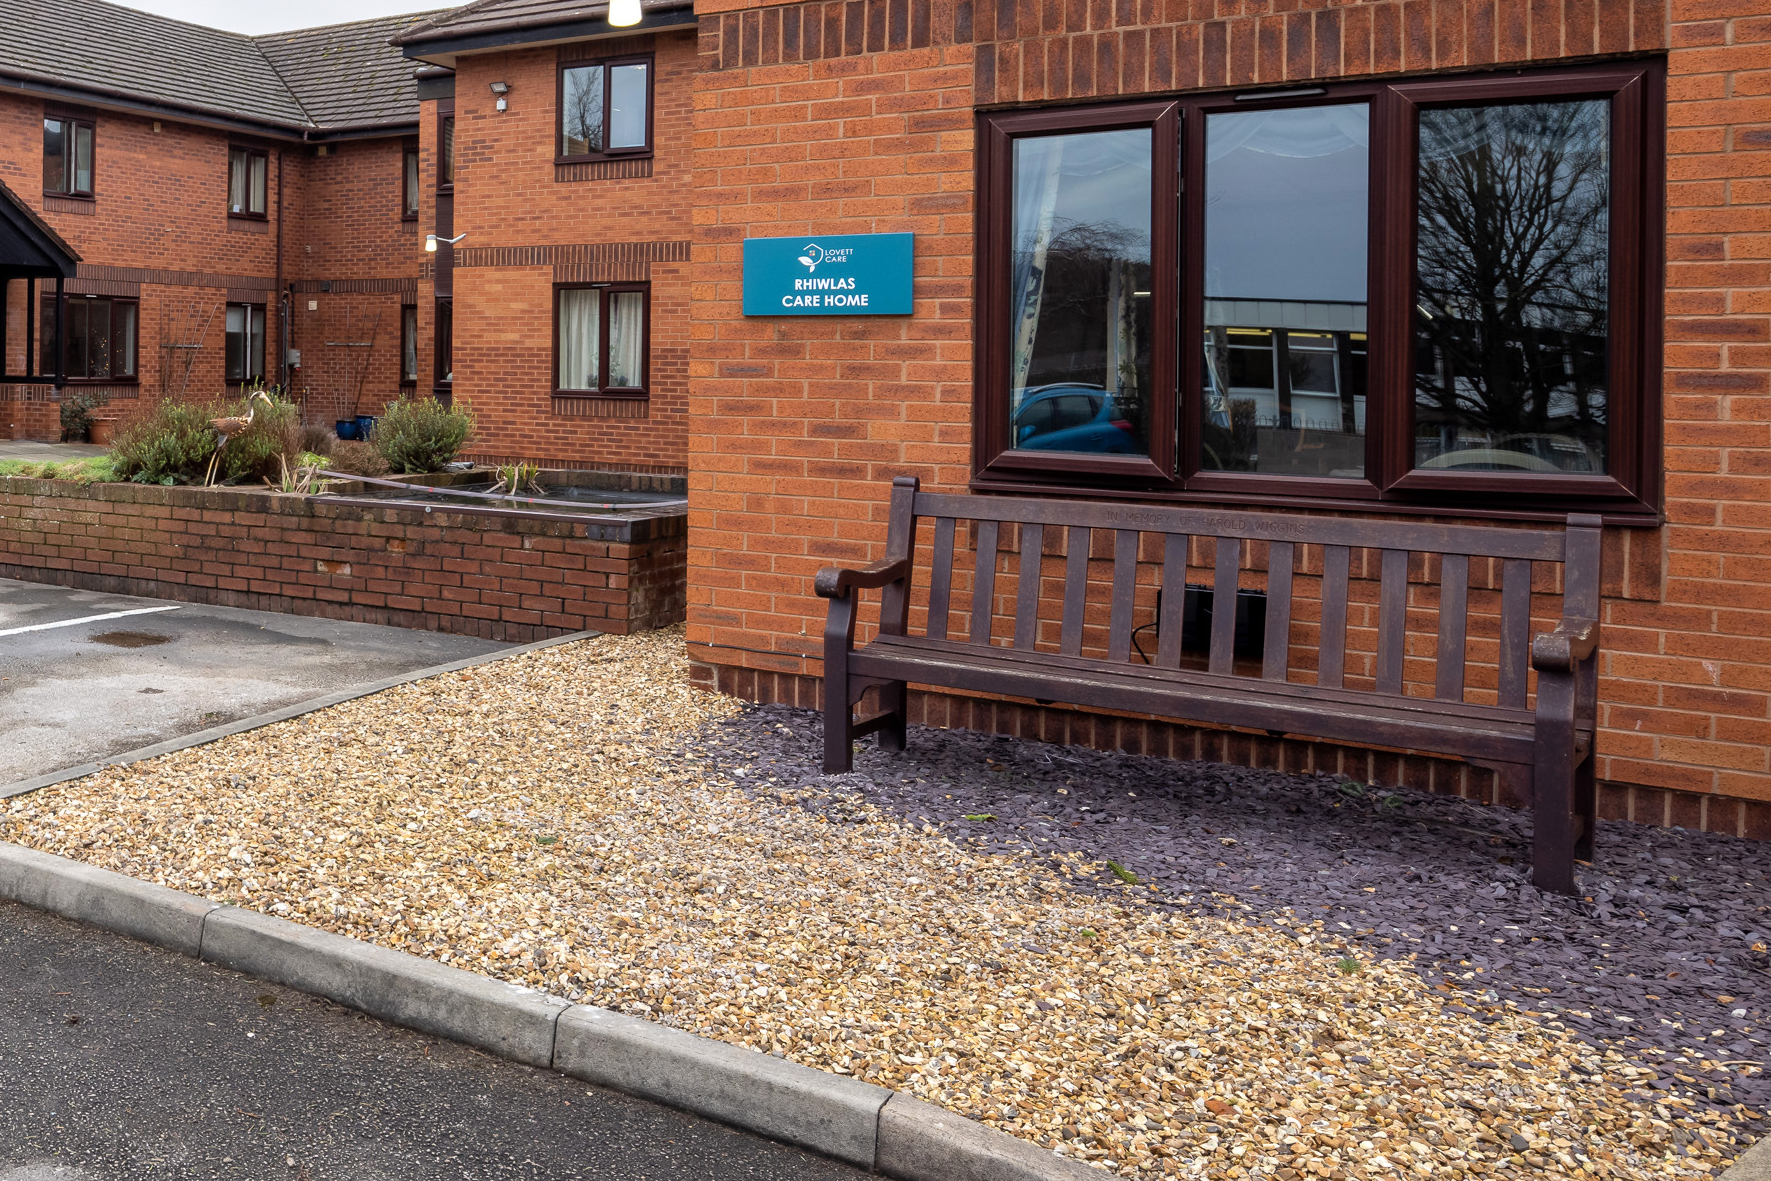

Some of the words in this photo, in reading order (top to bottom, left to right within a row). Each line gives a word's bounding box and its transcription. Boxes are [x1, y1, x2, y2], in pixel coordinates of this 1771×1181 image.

[825, 248, 853, 256] LOVETT
[794, 277, 856, 291] RHIWLAS
[781, 295, 821, 308] CARE
[824, 294, 869, 307] HOME
[1107, 510, 1118, 521] IN
[1125, 512, 1171, 524] MEMORY
[1179, 515, 1194, 526] OF
[1202, 517, 1246, 531] HAROLD
[1254, 521, 1306, 535] WIGGINS
